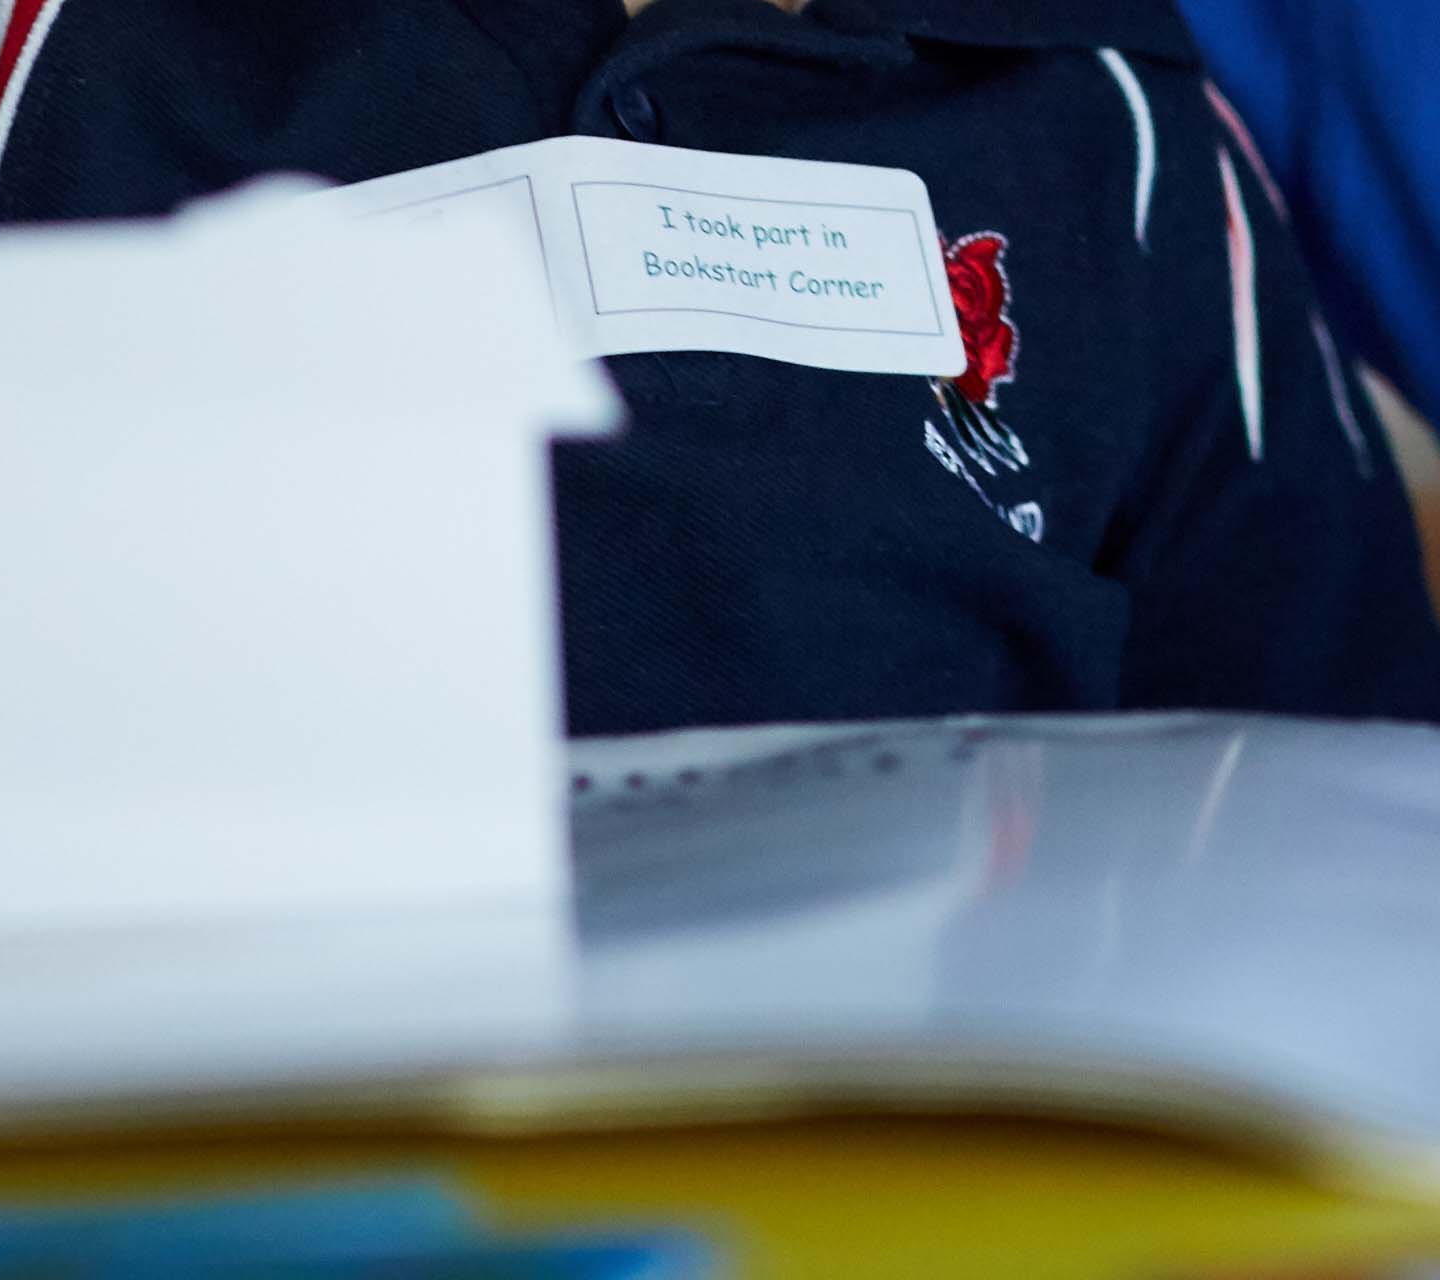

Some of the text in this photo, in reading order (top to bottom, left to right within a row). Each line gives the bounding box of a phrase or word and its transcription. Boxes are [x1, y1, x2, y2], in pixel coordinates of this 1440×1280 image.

[657, 204, 848, 249] I took part in
[642, 250, 885, 299] Bookstart Corner
